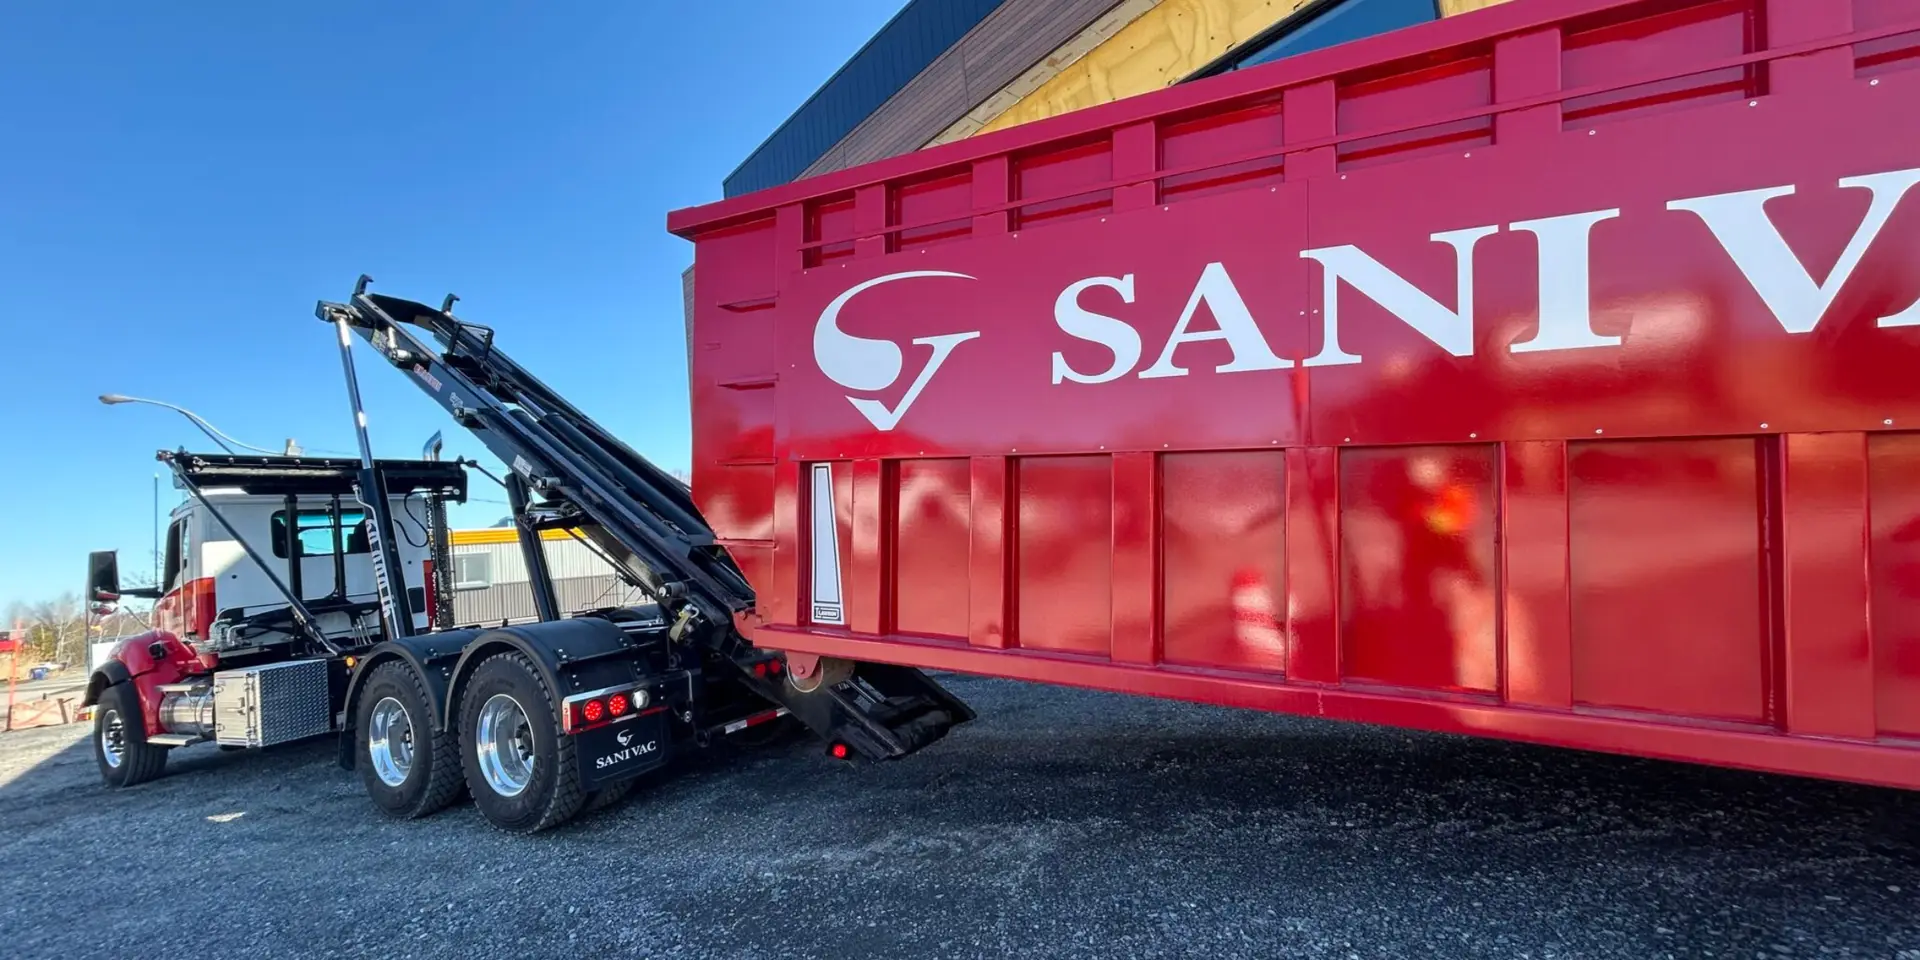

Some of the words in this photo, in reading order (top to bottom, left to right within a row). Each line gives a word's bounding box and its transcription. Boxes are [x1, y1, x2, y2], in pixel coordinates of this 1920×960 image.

[1052, 208, 1622, 385] SANI
[1667, 168, 1920, 334] V
[631, 741, 656, 756] VAC
